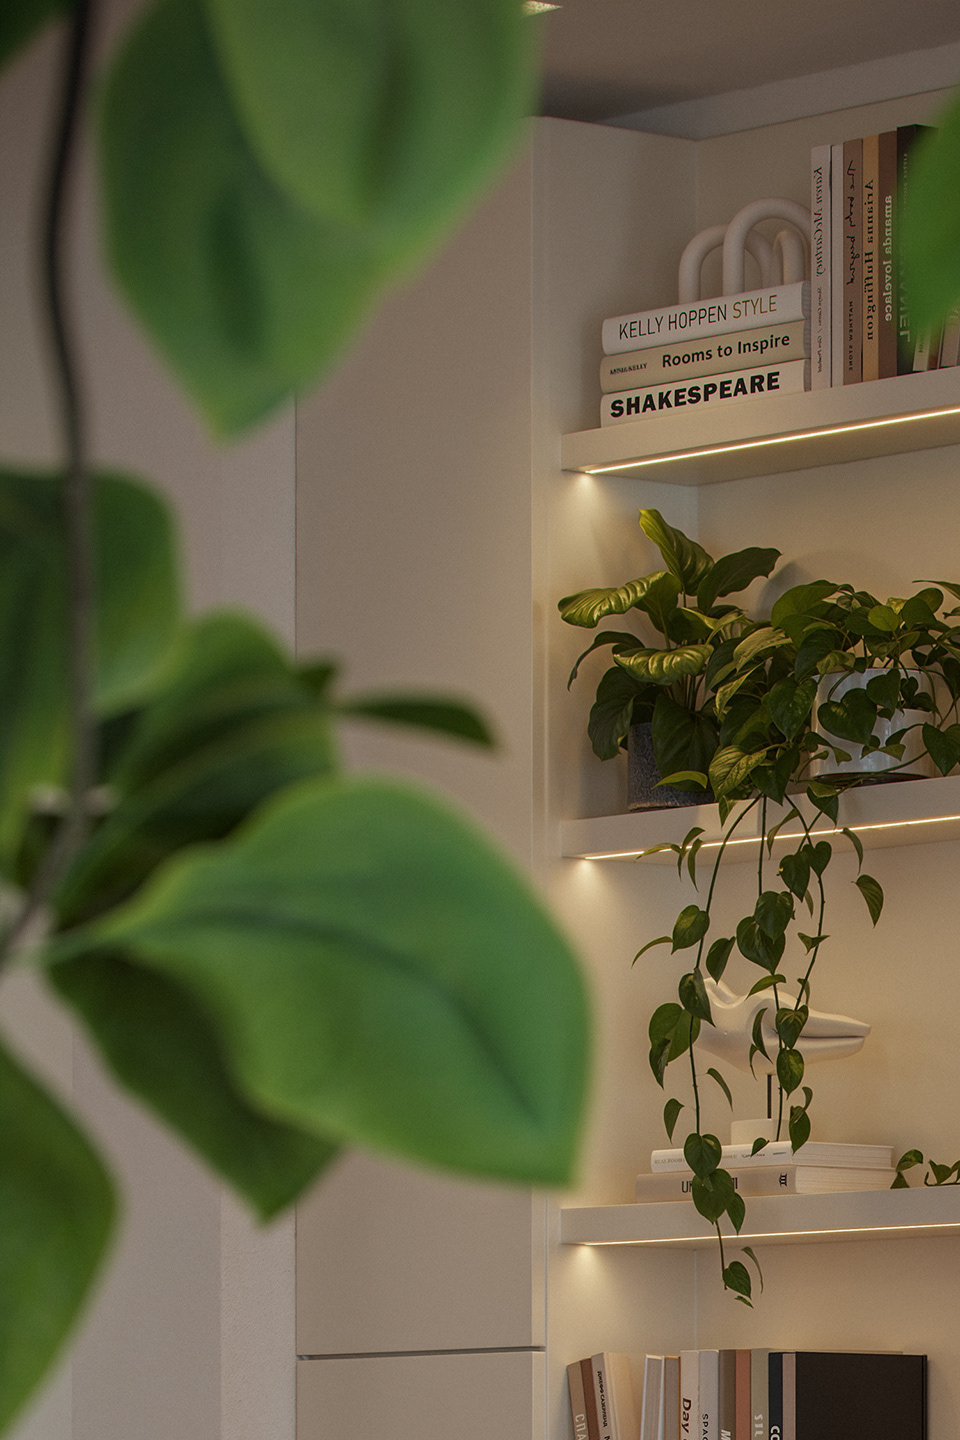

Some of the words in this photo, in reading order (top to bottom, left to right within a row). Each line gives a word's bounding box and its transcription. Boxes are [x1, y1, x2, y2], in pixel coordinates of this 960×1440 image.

[619, 315, 664, 340] KELLY
[668, 304, 727, 331] HOPPEN
[732, 294, 778, 319] STYLE
[628, 362, 648, 372] KELLY
[662, 349, 713, 368] Rooms
[717, 345, 732, 357] to
[738, 334, 790, 354] Inspire
[610, 371, 780, 418] SHAKESPEARE
[681, 1398, 692, 1434] Day
